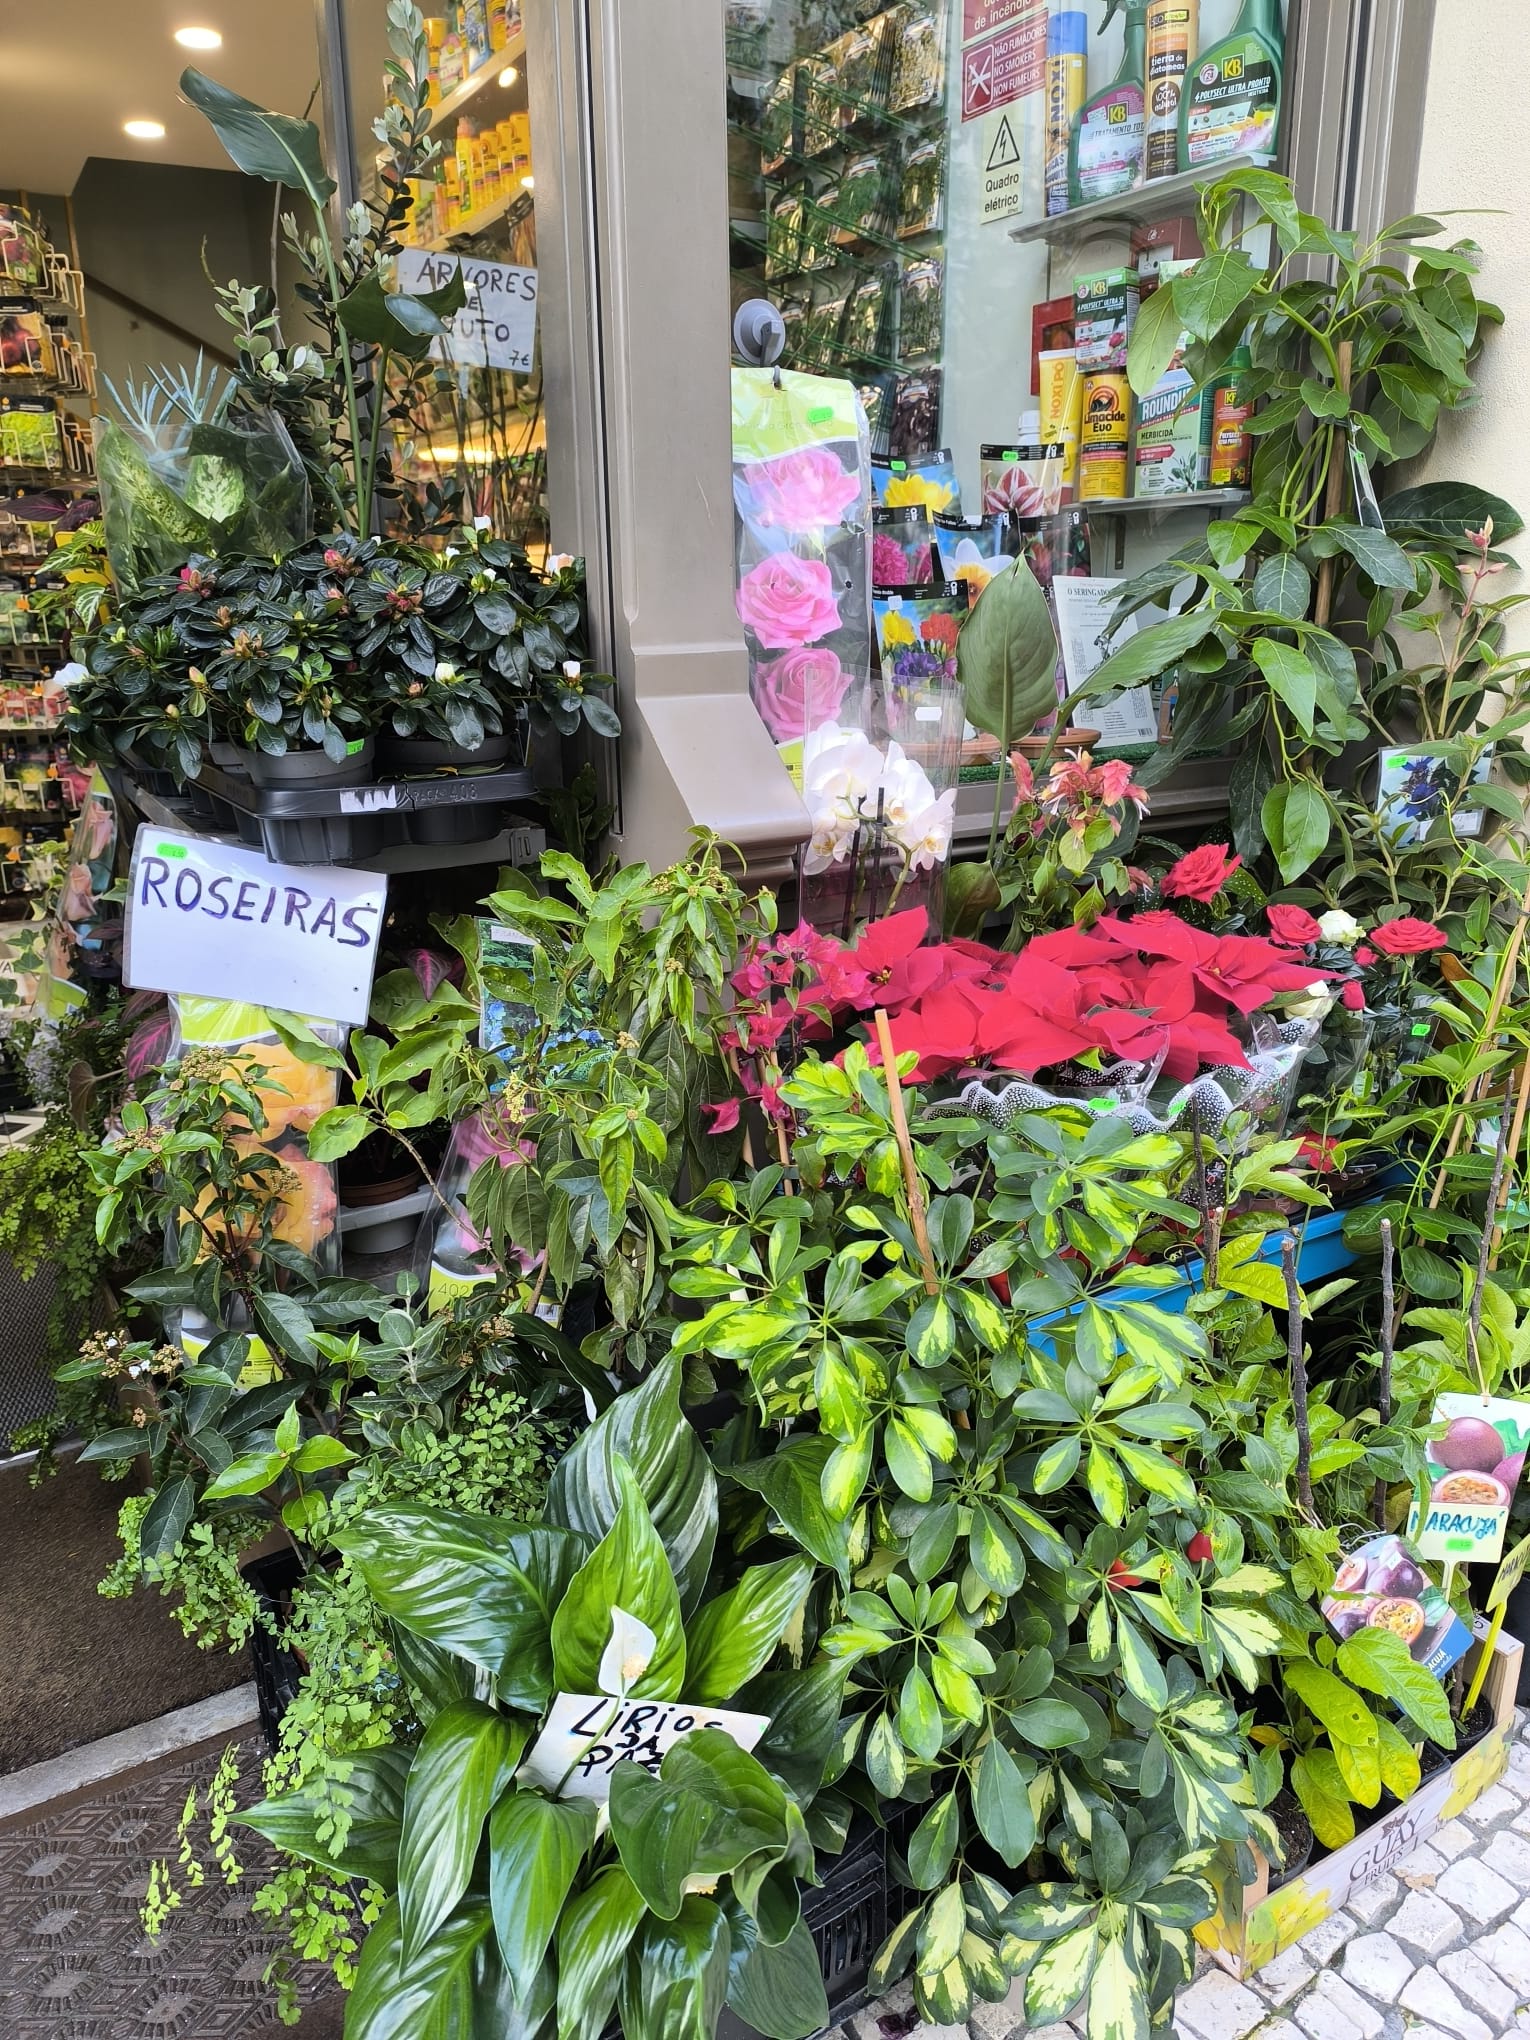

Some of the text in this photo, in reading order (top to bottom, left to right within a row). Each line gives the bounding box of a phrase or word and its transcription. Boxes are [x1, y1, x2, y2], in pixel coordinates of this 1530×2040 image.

[974, 15, 986, 31] de
[994, 23, 1047, 58] NÃO FUMADORES
[994, 48, 1037, 77] NO SMOKERS
[1151, 54, 1184, 67] tierra de
[1224, 57, 1242, 78] KB
[993, 66, 1041, 97] NON FUMEURS
[1227, 82, 1246, 95] ULTRA
[1247, 76, 1271, 89] PRONTO
[1109, 104, 1127, 124] KB
[985, 173, 1020, 192] Quadro
[984, 194, 1019, 213] elétrico
[1093, 281, 1106, 296] KB
[508, 349, 530, 367] 7€
[1140, 428, 1174, 440] HERBICIDA
[139, 856, 378, 949] ROSEIRAS
[437, 1282, 469, 1298] 402
[1349, 1808, 1425, 1882] GUAY
[1364, 1846, 1404, 1885] FRUITS
